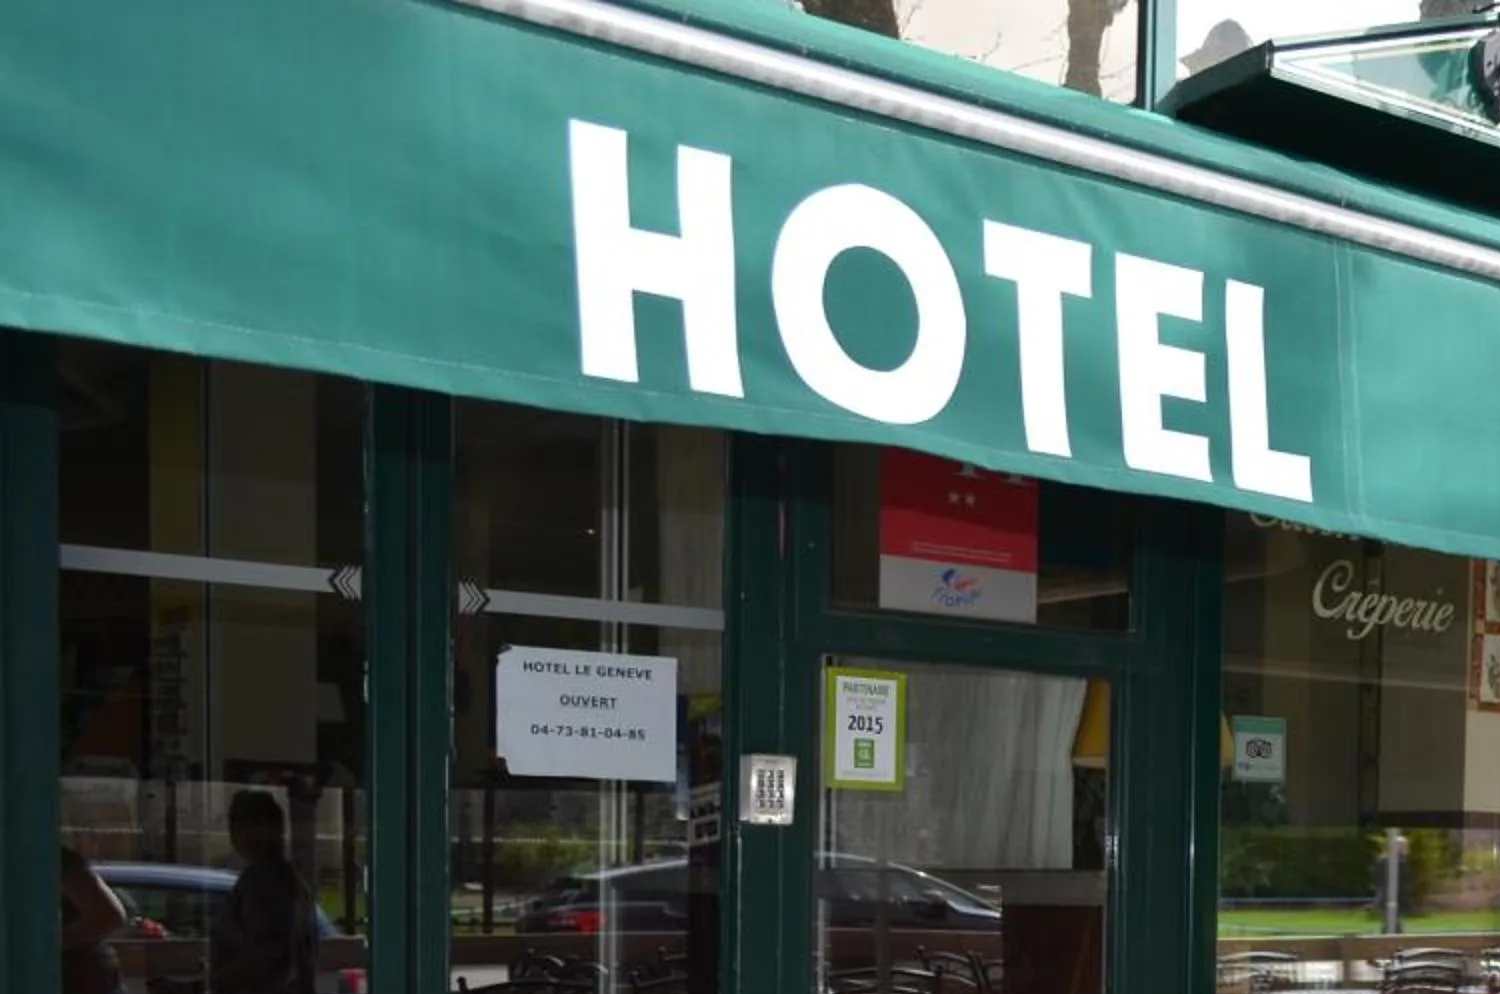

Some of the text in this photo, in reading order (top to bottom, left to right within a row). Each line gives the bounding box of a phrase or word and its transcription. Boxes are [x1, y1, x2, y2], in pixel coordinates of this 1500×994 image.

[569, 119, 1313, 502] HOTEL
[523, 661, 652, 681] HOTEL LE GENEVE
[559, 693, 617, 709] OUVERT
[848, 715, 883, 735] 2015
